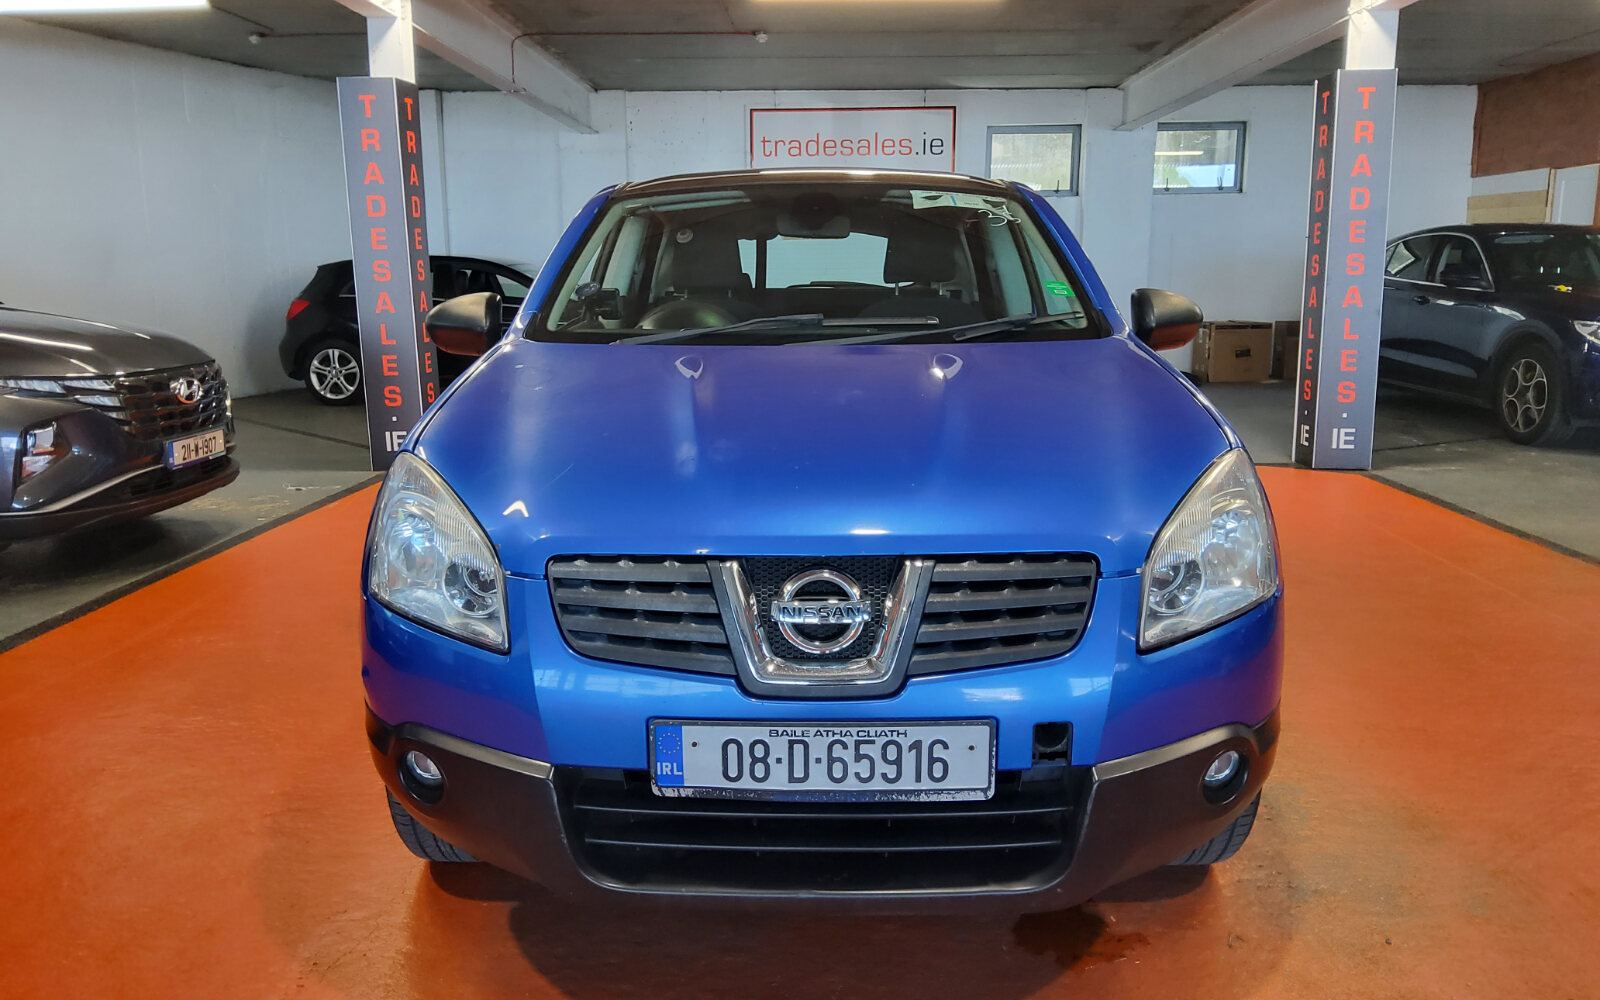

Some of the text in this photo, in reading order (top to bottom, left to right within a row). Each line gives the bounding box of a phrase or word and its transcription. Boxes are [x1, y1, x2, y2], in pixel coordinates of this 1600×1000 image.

[760, 131, 944, 157] tradesales.ie
[781, 605, 861, 620] NISSAN
[768, 729, 908, 739] BAILE ATHA CLIATH
[656, 761, 683, 776] IRL
